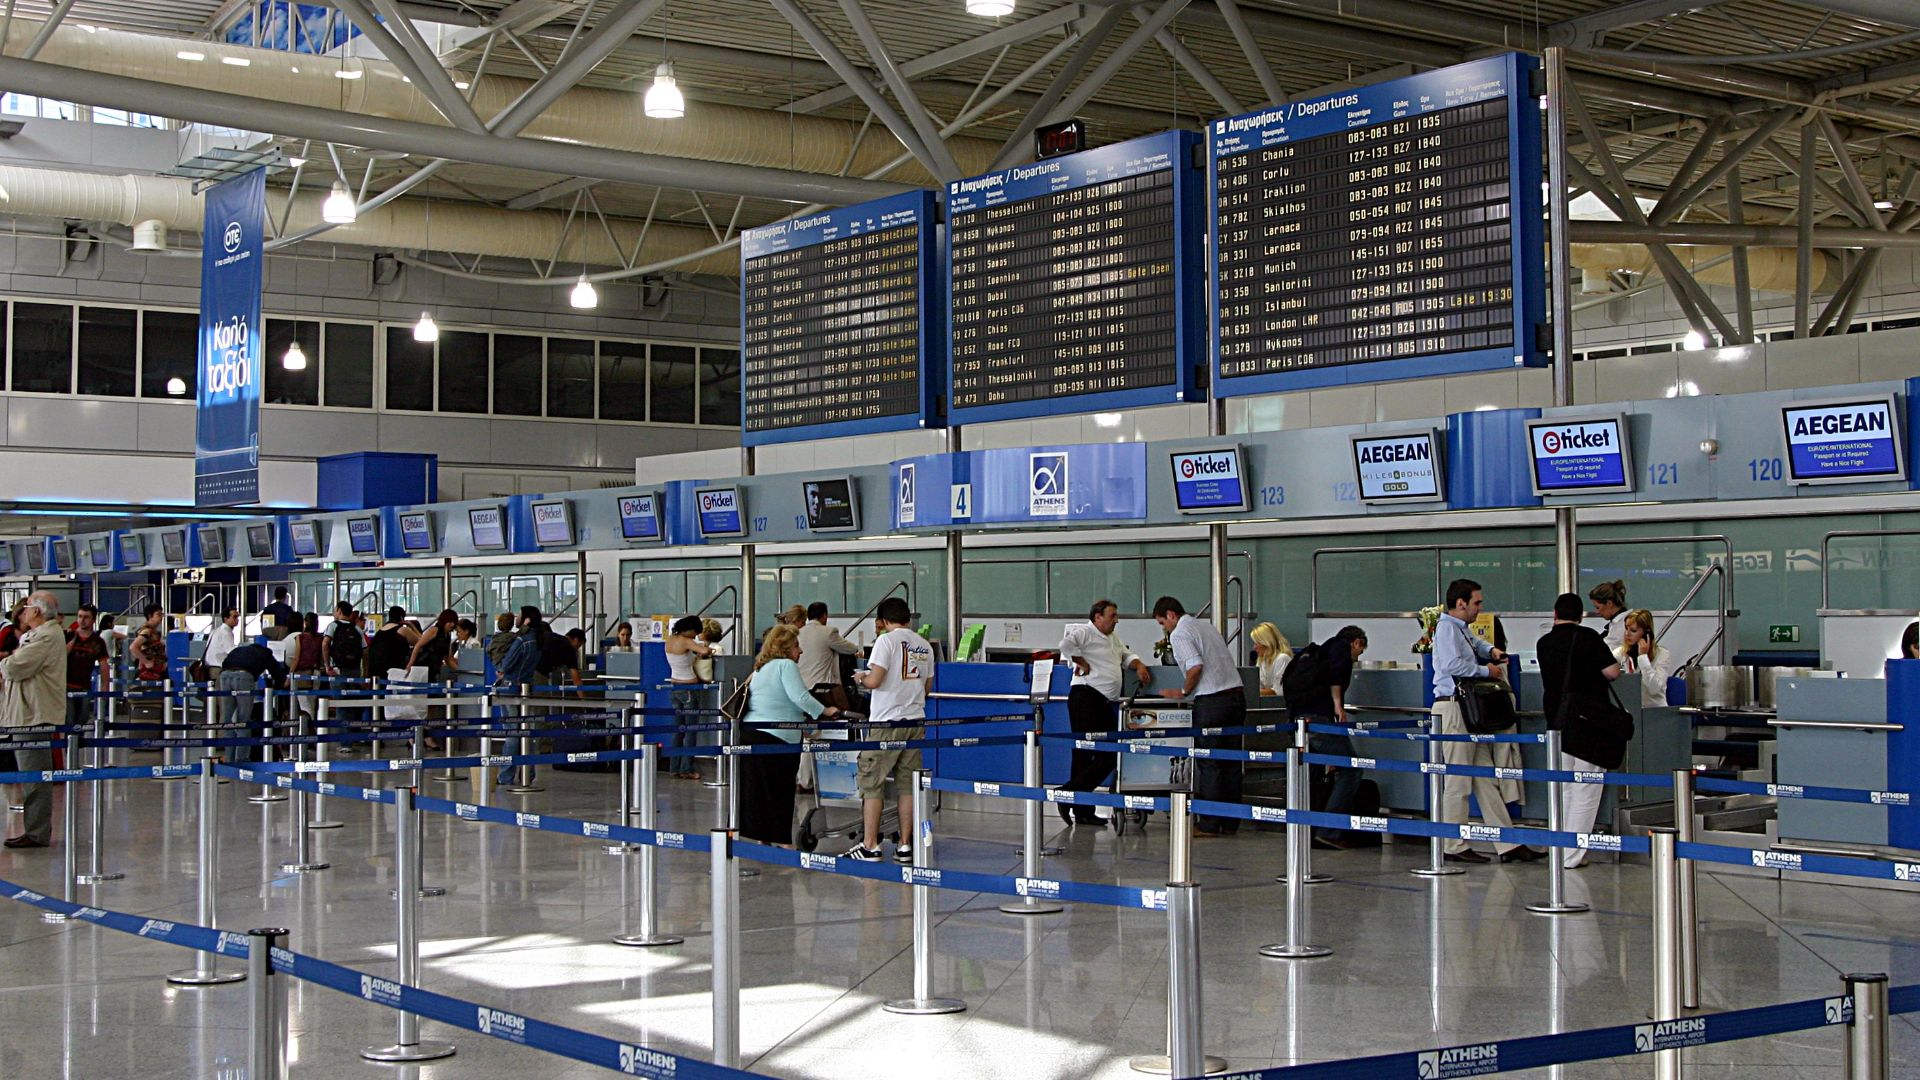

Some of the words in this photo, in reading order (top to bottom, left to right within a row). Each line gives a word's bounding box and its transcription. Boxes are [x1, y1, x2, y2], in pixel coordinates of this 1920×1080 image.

[1228, 110, 1284, 132] Αναχωρήσεις
[1298, 94, 1359, 117] Departures
[1263, 147, 1294, 161] Chania
[1417, 115, 1440, 131] 1835
[1349, 146, 1388, 163] 127-133
[1418, 135, 1441, 150] 1840
[1013, 161, 1060, 181] Departures
[1263, 183, 1306, 199] Iraklion
[1418, 155, 1441, 170] 1840
[987, 202, 1035, 219] Thessaloniki
[1105, 183, 1122, 195] 1800
[1263, 202, 1306, 218] Skiathos
[1419, 175, 1442, 190] 1840
[793, 214, 831, 230] Departures
[1233, 230, 1248, 242] 337
[1264, 222, 1301, 236] Larnaca
[1419, 195, 1442, 210] 1845
[1233, 249, 1248, 260] 331
[1264, 242, 1301, 256] Larnaca
[1420, 216, 1443, 230] 1845
[1264, 260, 1296, 274] Munich
[1420, 236, 1443, 250] 1855
[1264, 276, 1312, 293] Santorini
[1351, 265, 1390, 281] 127-133
[1420, 256, 1443, 270] 1900
[1265, 297, 1307, 312] Istanbul
[1421, 277, 1444, 290] 1900
[1265, 318, 1297, 331] London
[1302, 314, 1319, 326] LHR
[1421, 297, 1444, 311] 1905
[1450, 294, 1475, 307] Late
[1482, 288, 1512, 302] 19:30
[214, 315, 247, 351] Καλό
[1266, 337, 1303, 352] Mykonos
[1353, 324, 1391, 339] 127-133
[1422, 318, 1445, 331] 1910
[1266, 356, 1292, 369] Paris
[1353, 343, 1392, 359] 111-114
[1423, 338, 1445, 351] 1910
[208, 347, 251, 398] ταξίδι
[1794, 411, 1885, 437] AEGEAN
[1361, 443, 1429, 464] AEGEAN
[1648, 463, 1678, 485] 121
[1748, 458, 1783, 481] 120
[1261, 486, 1285, 506] 123
[1384, 483, 1408, 491] GOLD
[956, 487, 966, 515] 4
[352, 522, 372, 533] AEGEAN
[473, 511, 498, 525] AEGEAN
[754, 517, 768, 532] 127
[1158, 713, 1191, 721] Greece
[53, 768, 83, 776] ATHENS
[1776, 784, 1803, 793] ATHENS
[1261, 806, 1287, 816] ATHENS
[1360, 816, 1388, 825] ATHENS
[1471, 826, 1500, 836] ATHENS
[1588, 833, 1621, 843] ATHENS
[810, 853, 836, 865] ATHENS
[1765, 851, 1802, 863] ATHENS
[912, 868, 941, 879] ATHENS
[1027, 879, 1060, 891] ATHENS
[226, 931, 250, 946] ATHENS
[371, 977, 401, 996] ATHENS
[491, 1011, 525, 1031] ATHENS
[1655, 1018, 1706, 1037] ATHENS
[635, 1048, 676, 1070] ATHENS
[1440, 1045, 1498, 1064] ATHENS
